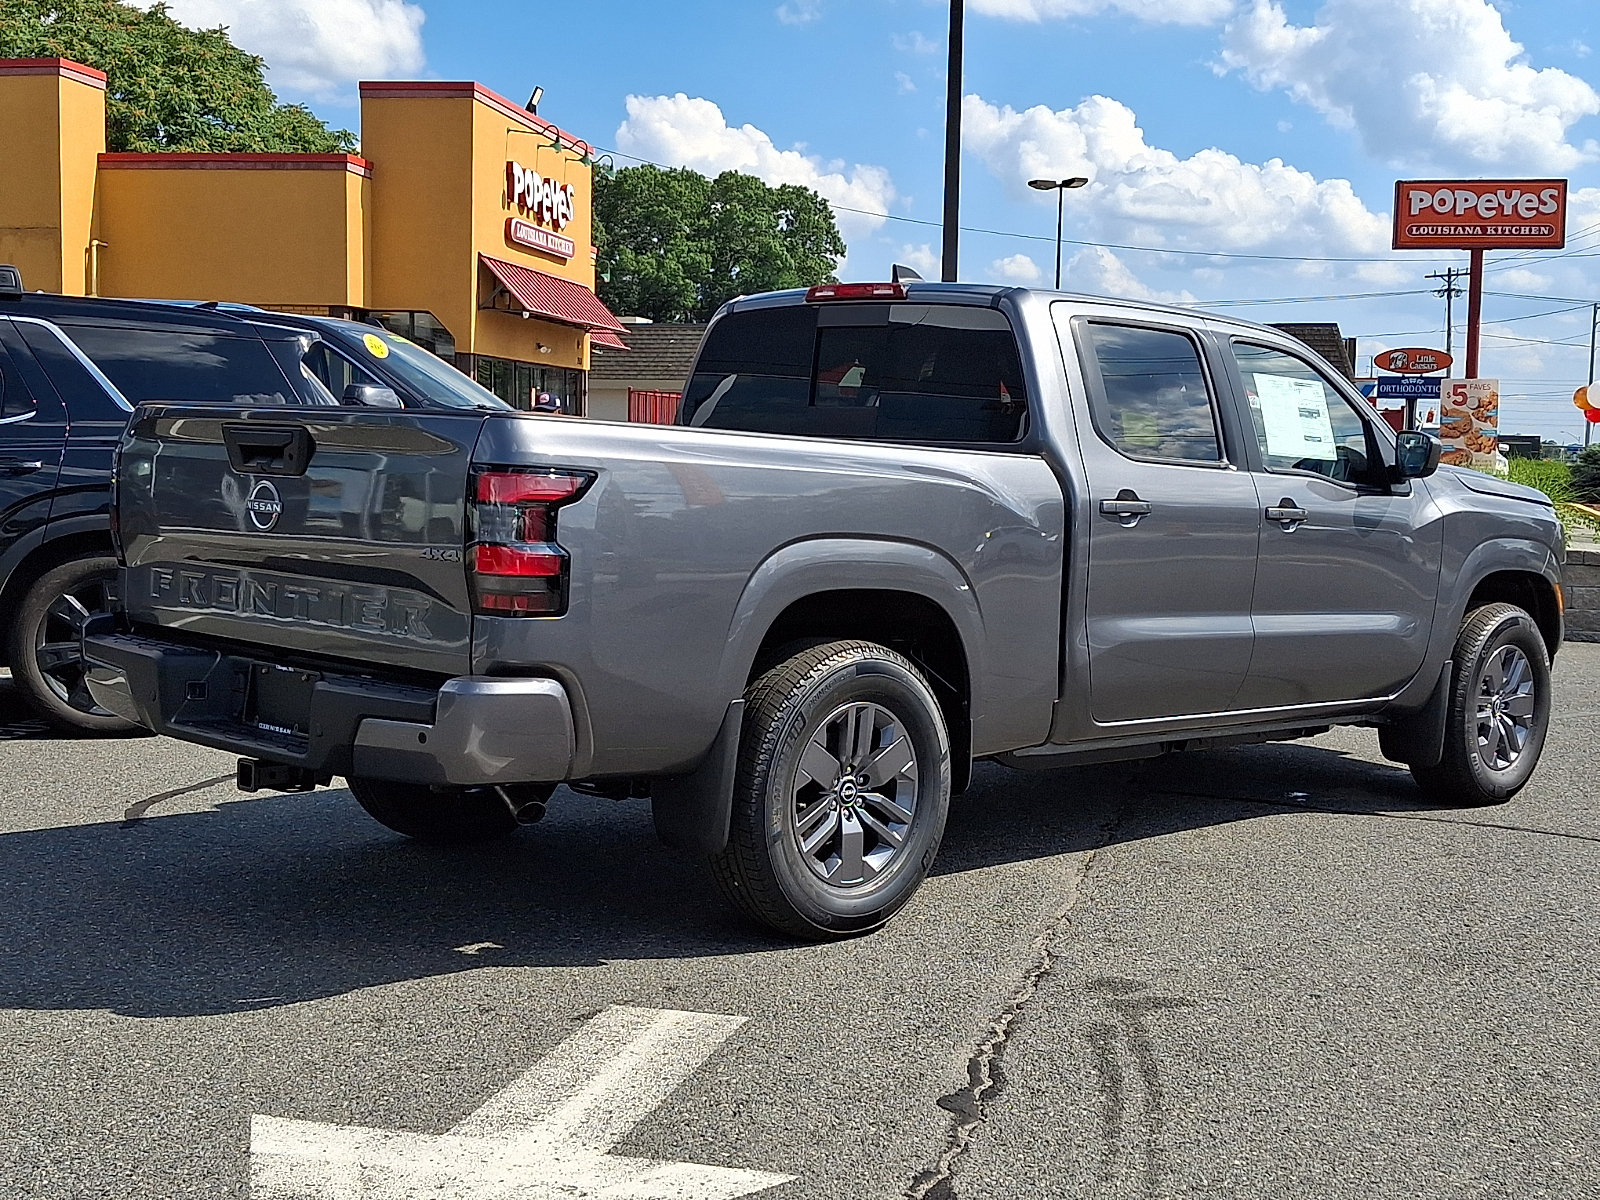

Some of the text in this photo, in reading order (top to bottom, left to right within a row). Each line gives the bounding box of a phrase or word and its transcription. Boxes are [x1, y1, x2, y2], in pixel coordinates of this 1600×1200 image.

[1411, 226, 1550, 235] LOUISIANA KITCHEN
[516, 223, 574, 256] LOUISIANA KITCHEN
[1416, 354, 1436, 363] Little
[1410, 361, 1438, 370] Caesars
[1470, 383, 1491, 391] FAVES
[247, 500, 281, 512] NISSAN
[150, 566, 434, 640] FRONTIER
